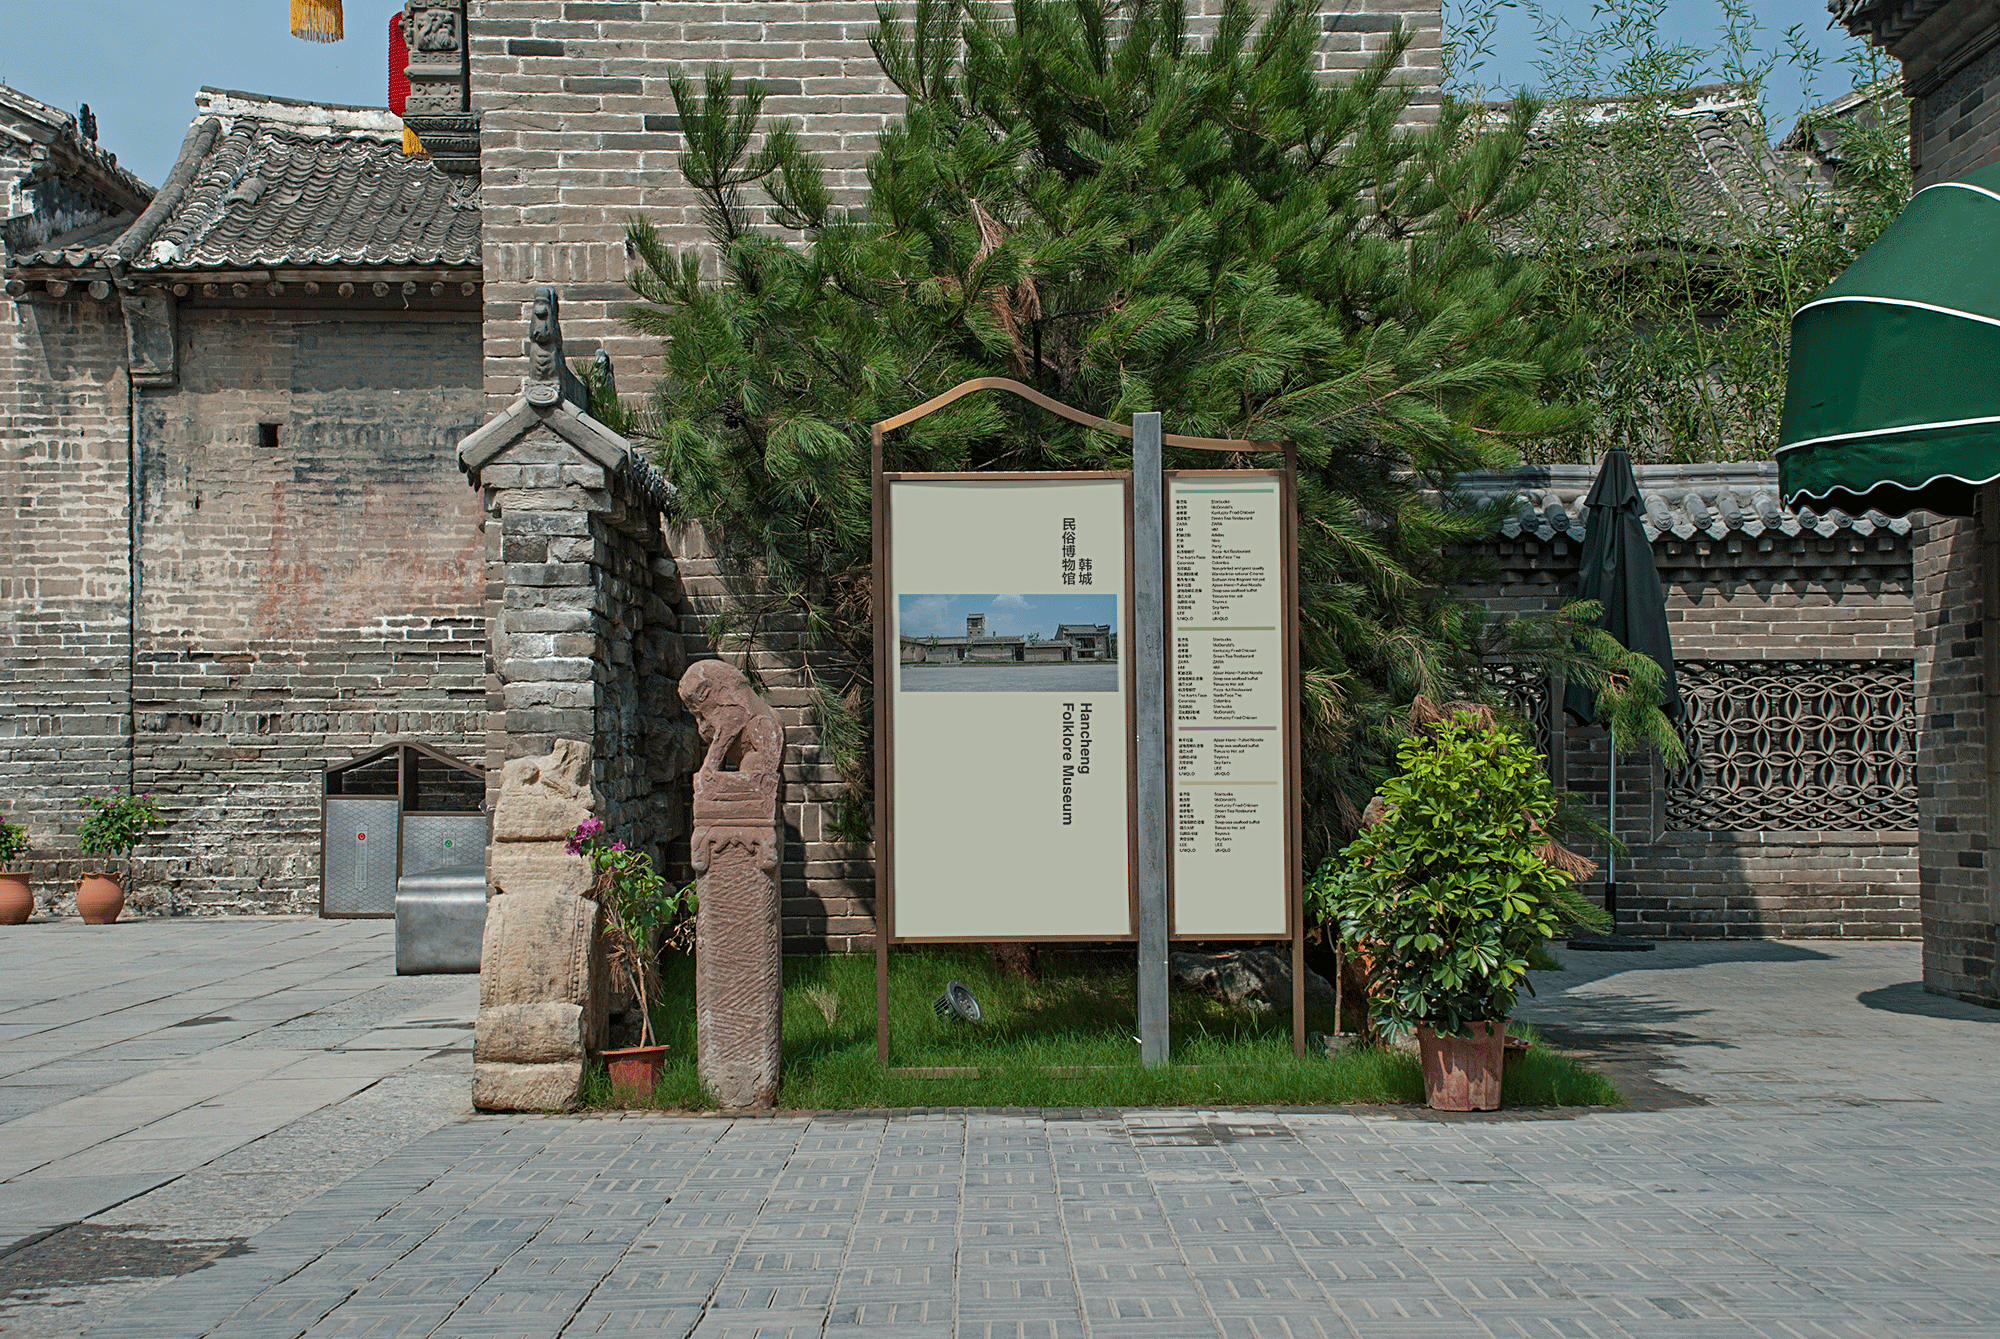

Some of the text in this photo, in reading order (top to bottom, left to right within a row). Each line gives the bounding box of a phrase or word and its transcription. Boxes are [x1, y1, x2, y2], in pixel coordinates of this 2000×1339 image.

[1061, 517, 1076, 586] 民俗博物馆
[1078, 557, 1093, 586] 韩城
[1062, 702, 1075, 826] Folklore Museum
[1077, 702, 1093, 774] Hancheng
